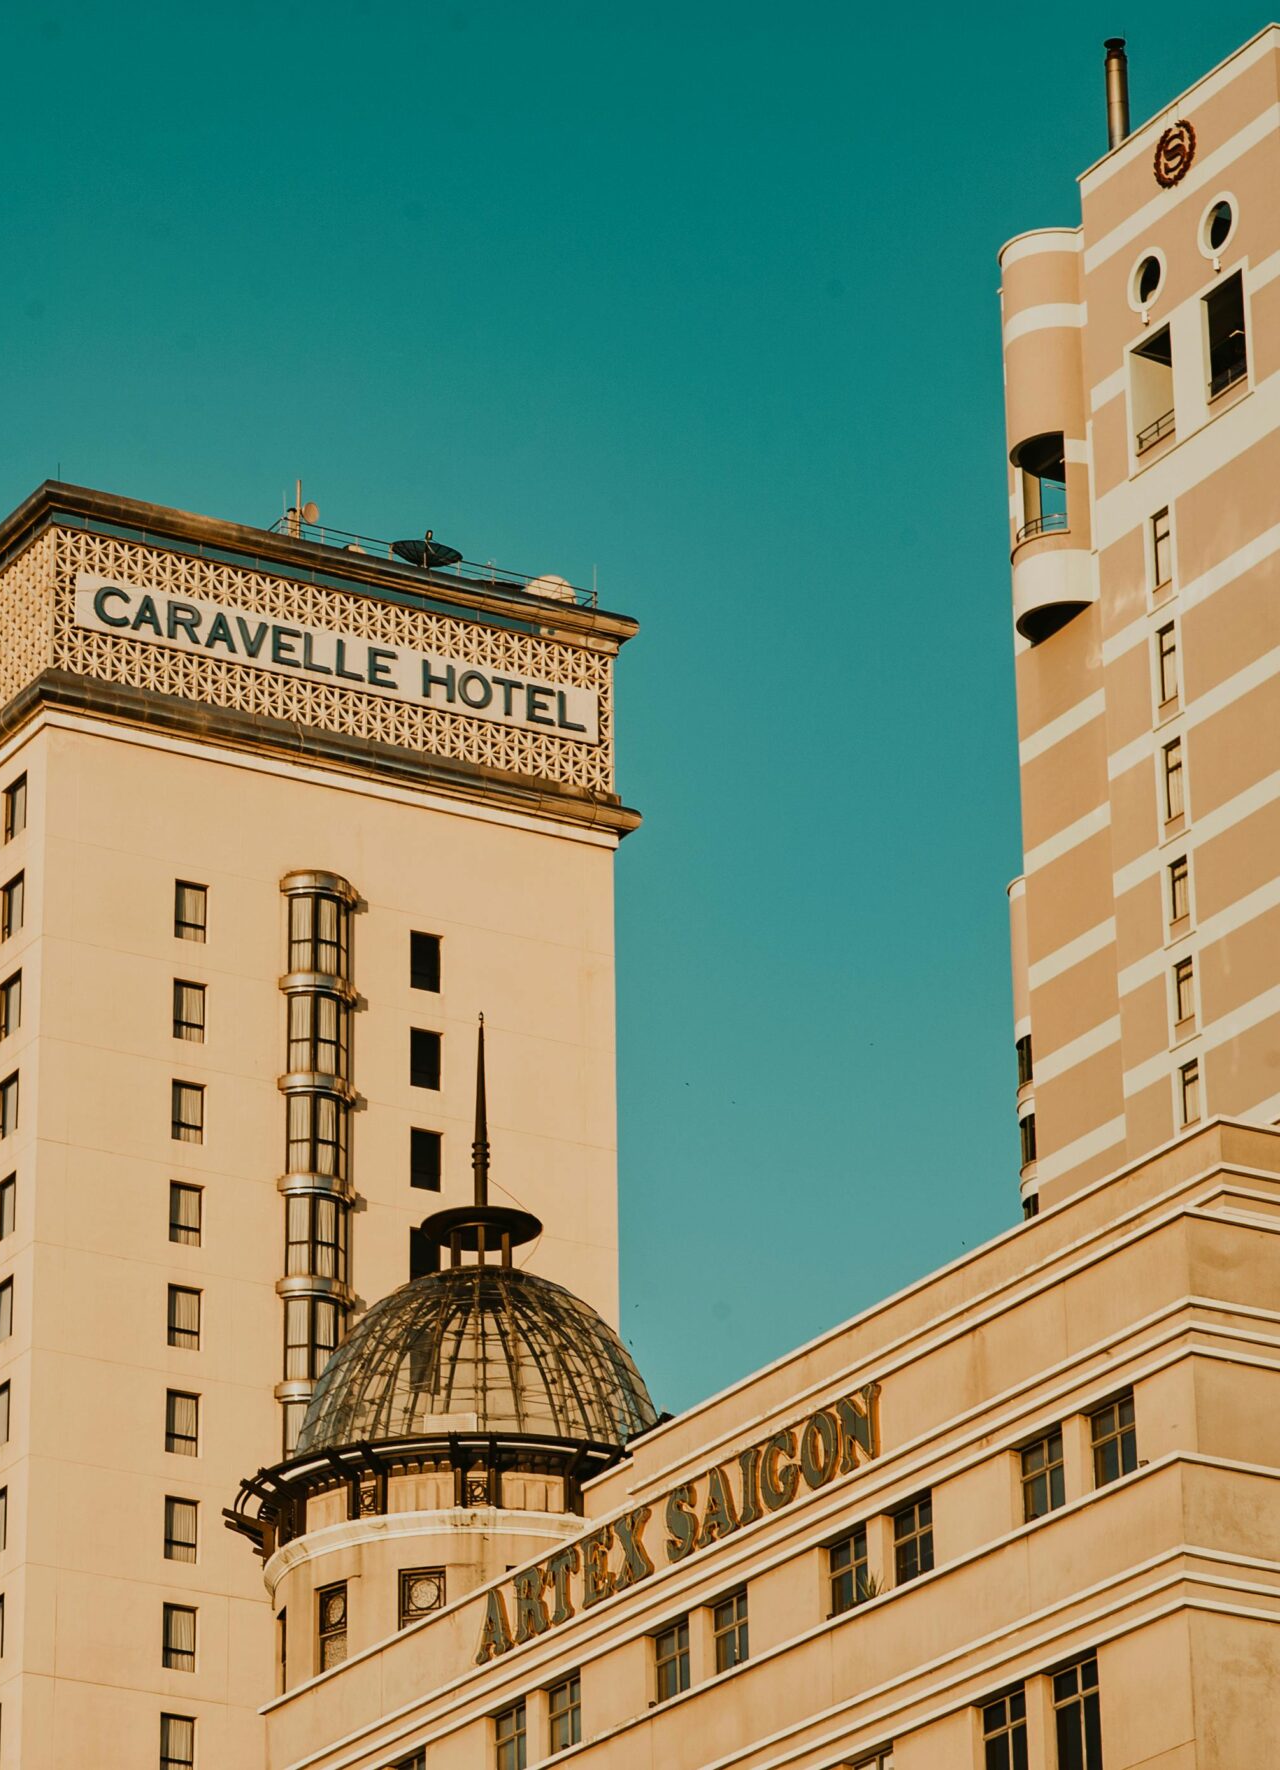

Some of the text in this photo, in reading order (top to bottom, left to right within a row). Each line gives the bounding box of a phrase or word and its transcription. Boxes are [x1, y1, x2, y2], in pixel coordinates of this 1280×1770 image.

[1163, 129, 1187, 175] S
[93, 586, 588, 733] CARAVELLE HOTEL
[475, 1383, 882, 1665] ARTEX SAIGON
